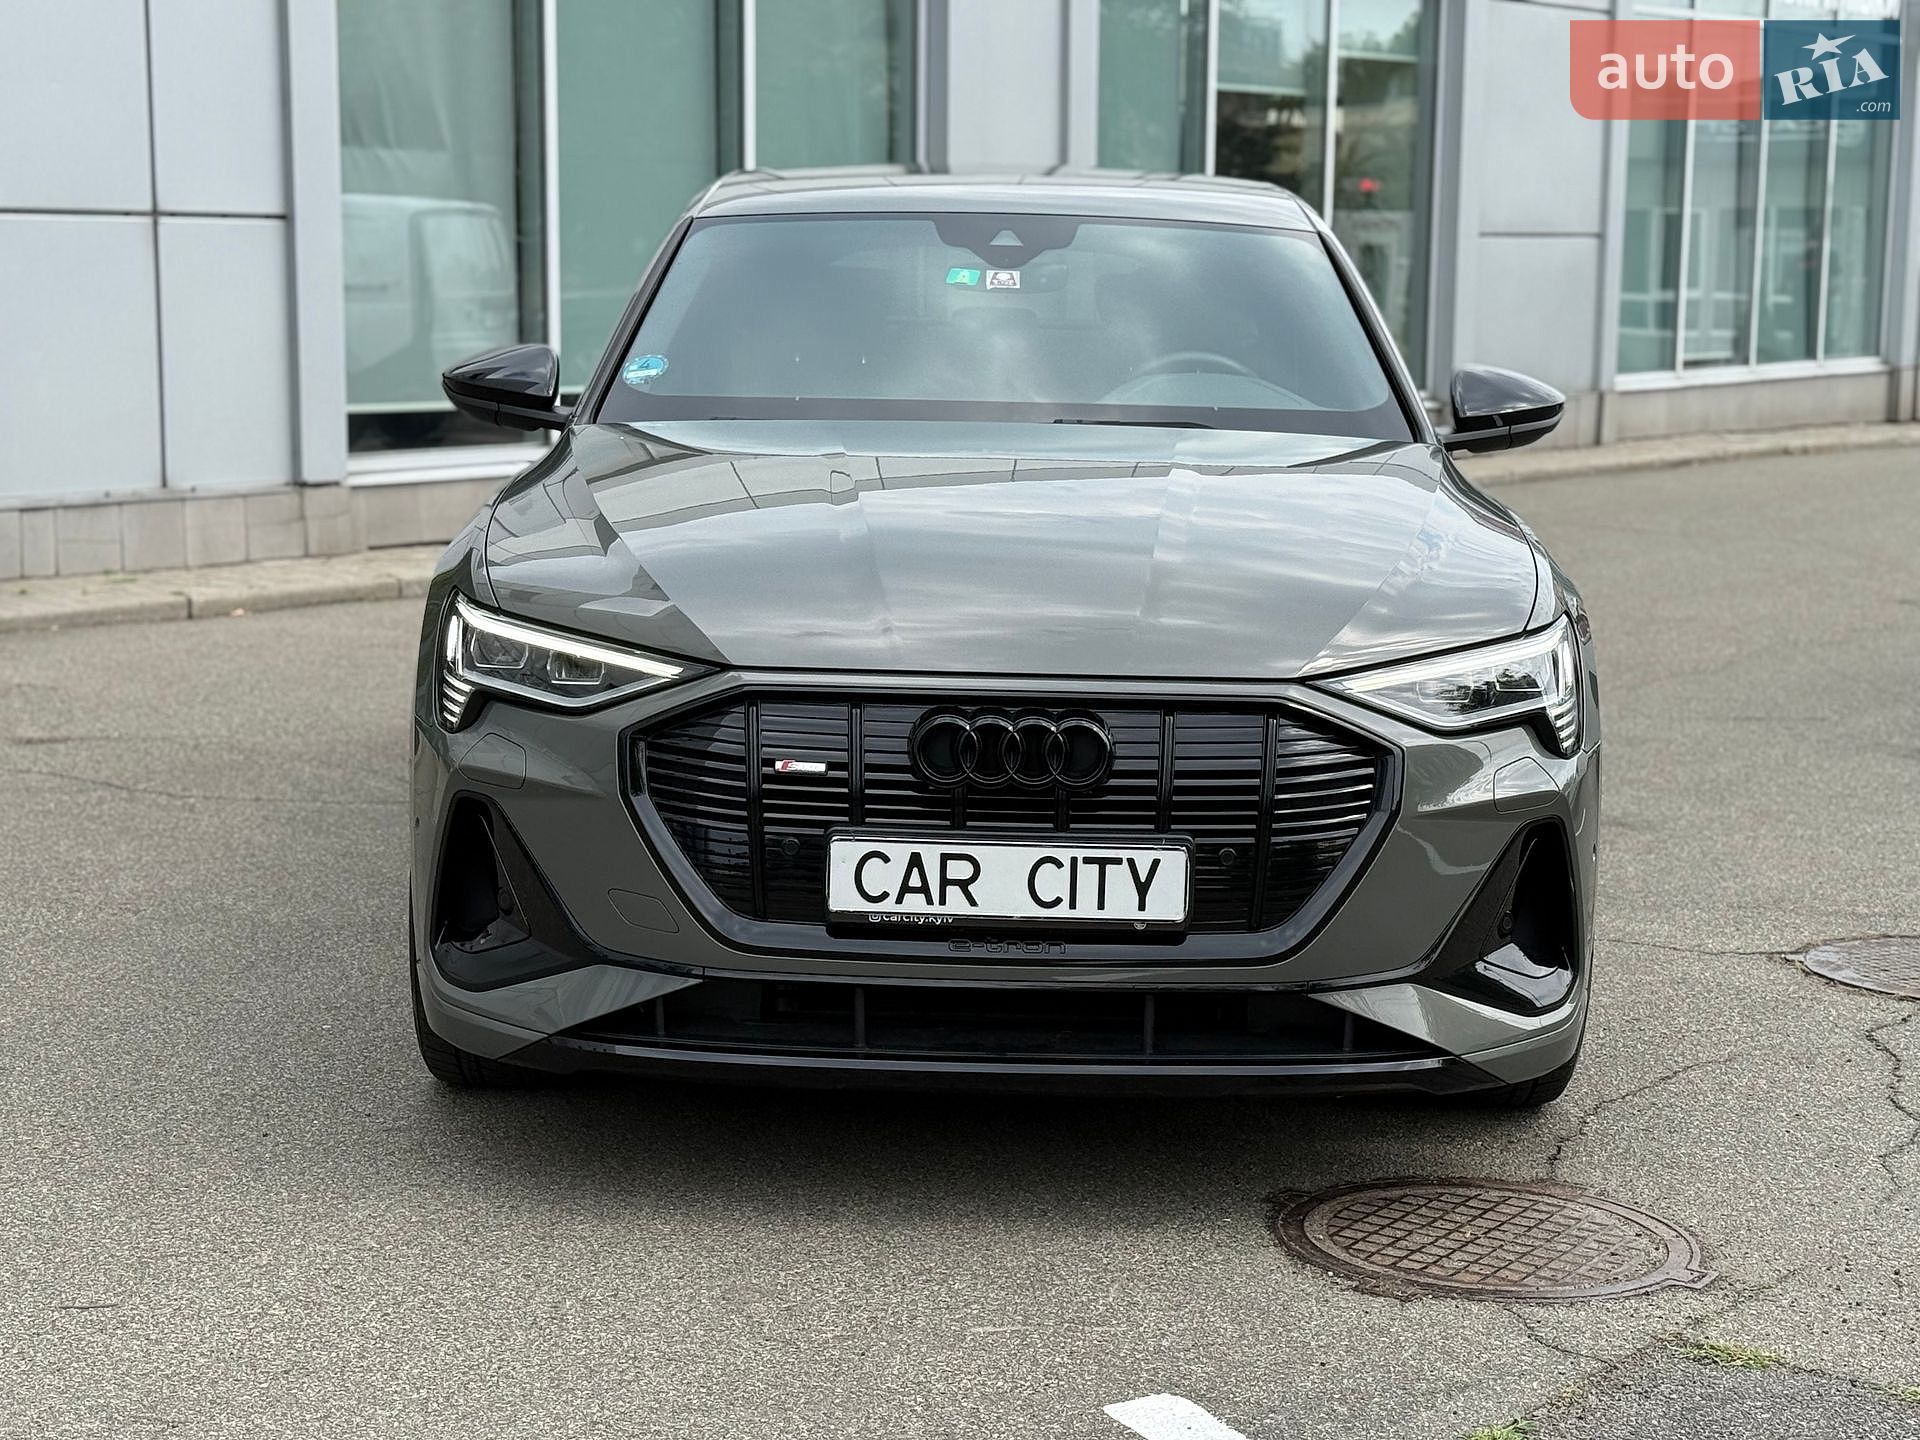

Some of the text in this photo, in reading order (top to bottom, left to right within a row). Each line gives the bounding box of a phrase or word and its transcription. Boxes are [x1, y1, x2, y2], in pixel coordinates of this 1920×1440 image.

[854, 850, 1162, 912] CAR CITY
[947, 936, 1067, 955] e-tron
